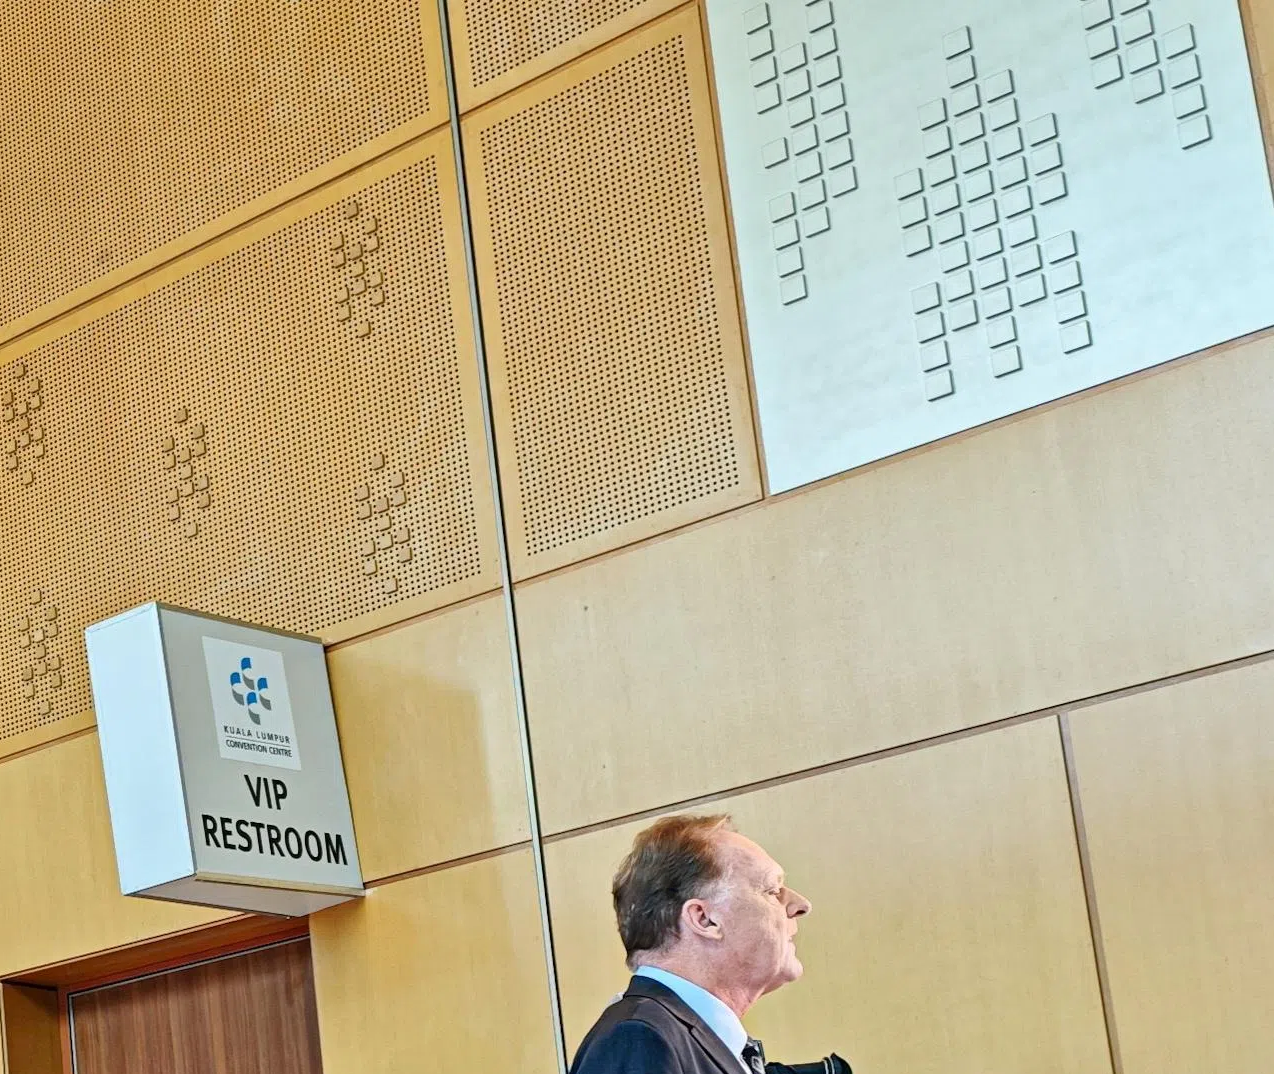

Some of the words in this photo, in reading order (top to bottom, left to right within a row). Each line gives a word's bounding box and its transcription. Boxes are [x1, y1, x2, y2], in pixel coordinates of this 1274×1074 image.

[223, 725, 253, 737] KUALA
[256, 730, 291, 745] LUMPUR
[225, 739, 267, 753] CONVENTION
[268, 746, 293, 758] CENTRE
[244, 774, 288, 811] VIP
[202, 814, 349, 866] RESTROOM
